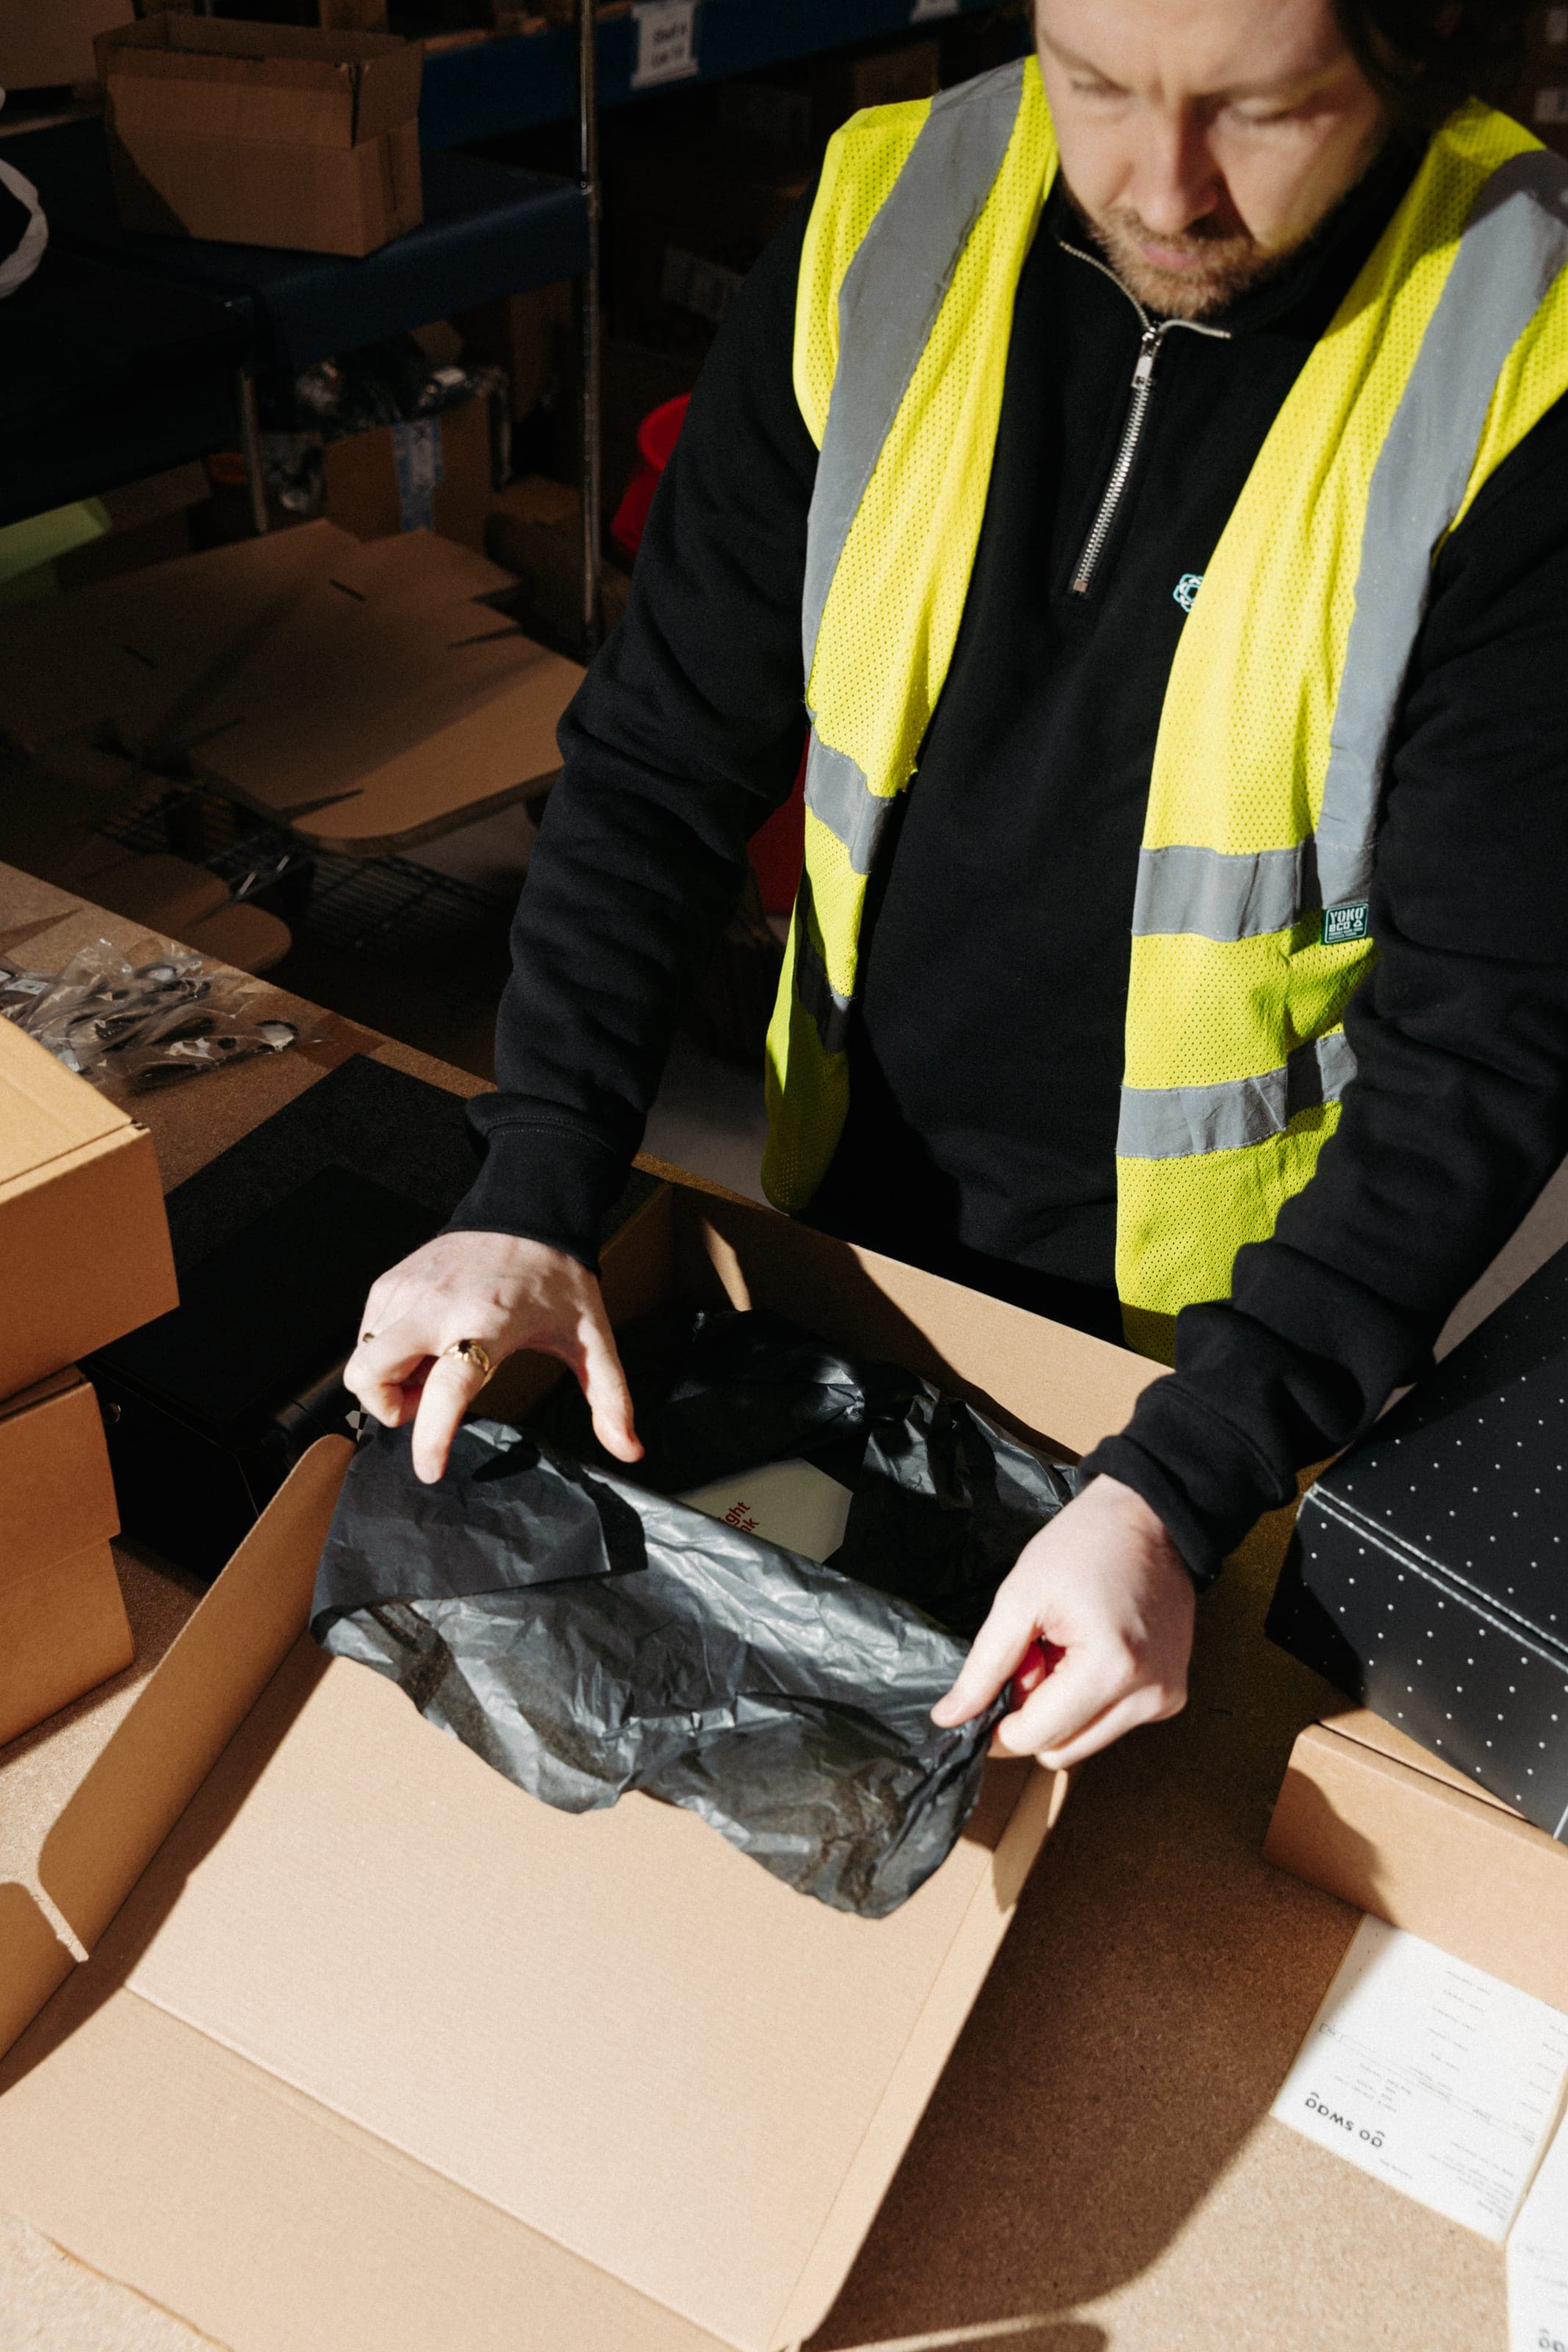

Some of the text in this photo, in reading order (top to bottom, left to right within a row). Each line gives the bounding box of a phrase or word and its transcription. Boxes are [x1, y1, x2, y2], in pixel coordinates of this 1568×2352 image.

[1330, 907, 1364, 924] YOKO
[1305, 2092, 1385, 2148] go swag
